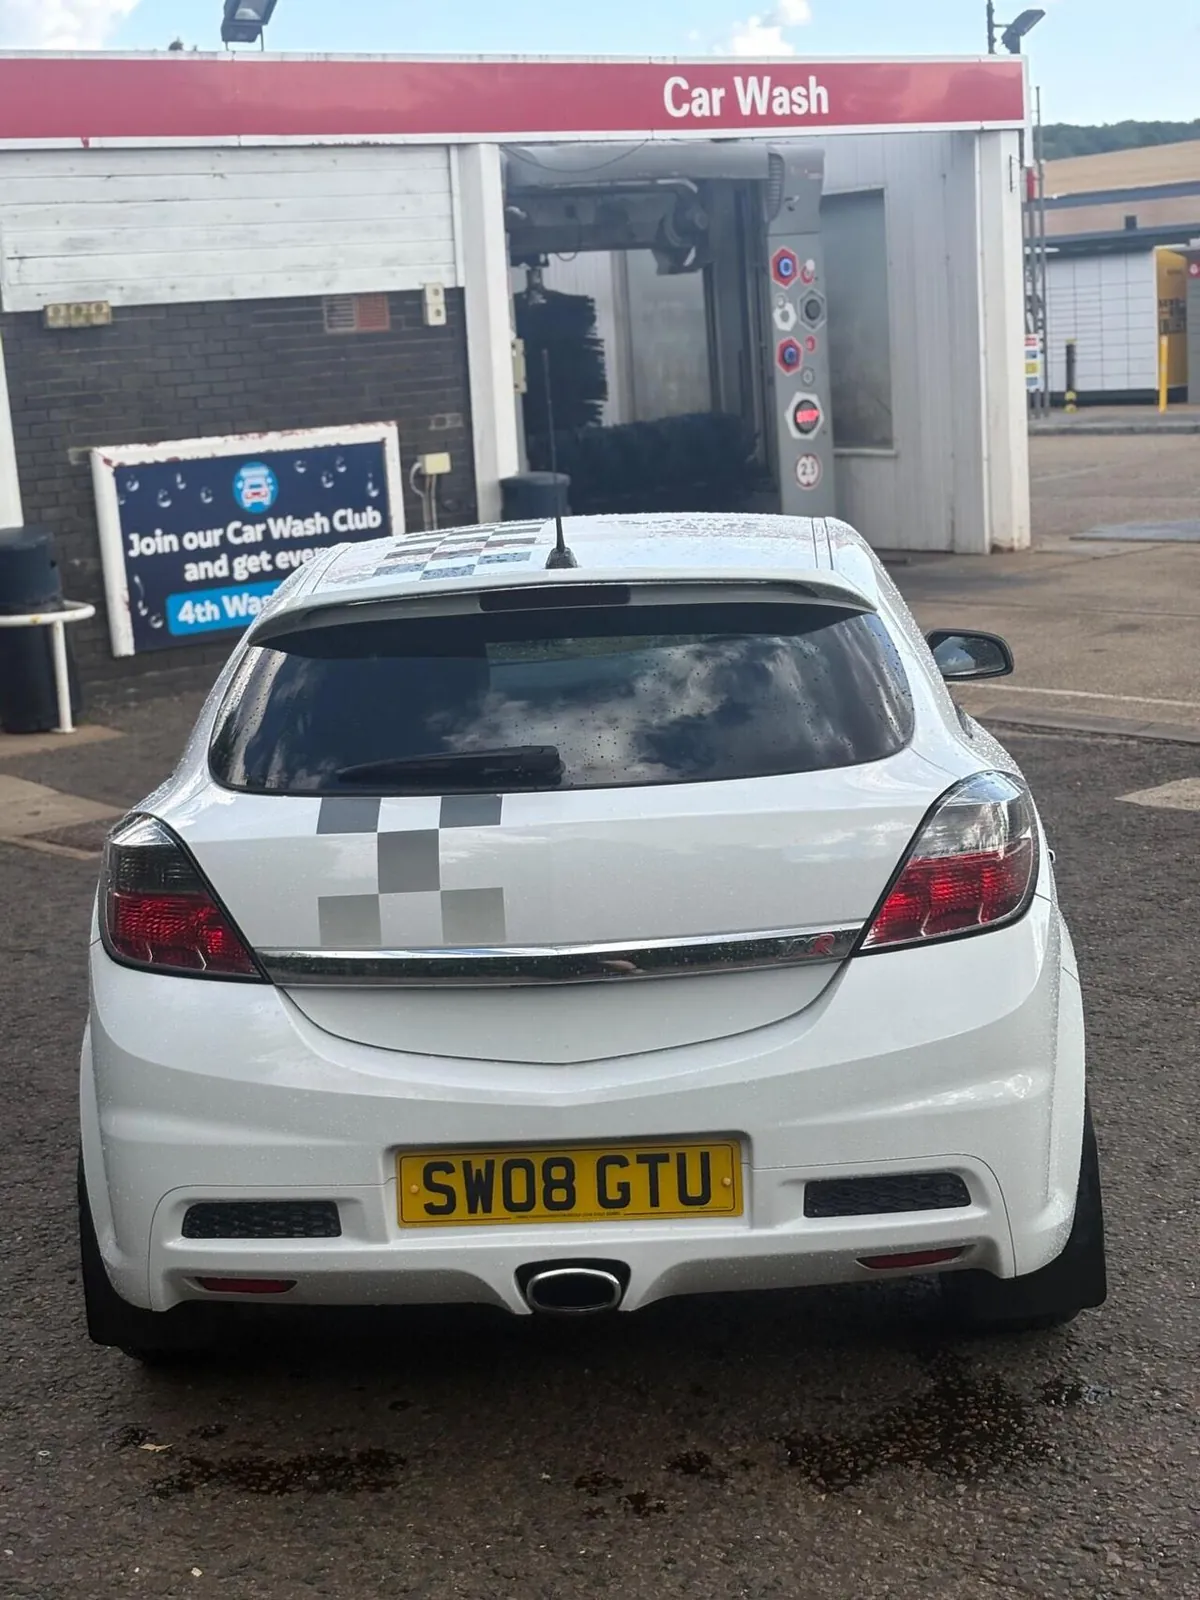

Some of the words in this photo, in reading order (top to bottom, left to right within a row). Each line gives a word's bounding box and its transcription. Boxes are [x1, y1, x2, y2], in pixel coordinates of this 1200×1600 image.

[664, 76, 726, 118] Car
[733, 75, 829, 116] Wash
[127, 528, 179, 557] Join
[183, 527, 224, 551] our
[226, 521, 267, 546] Car
[268, 510, 330, 540] Wash
[333, 506, 382, 532] Club
[184, 553, 228, 582] and
[233, 550, 272, 581] get
[177, 599, 220, 625] 4th
[422, 1156, 576, 1215] SW08
[596, 1151, 711, 1209] GTU
